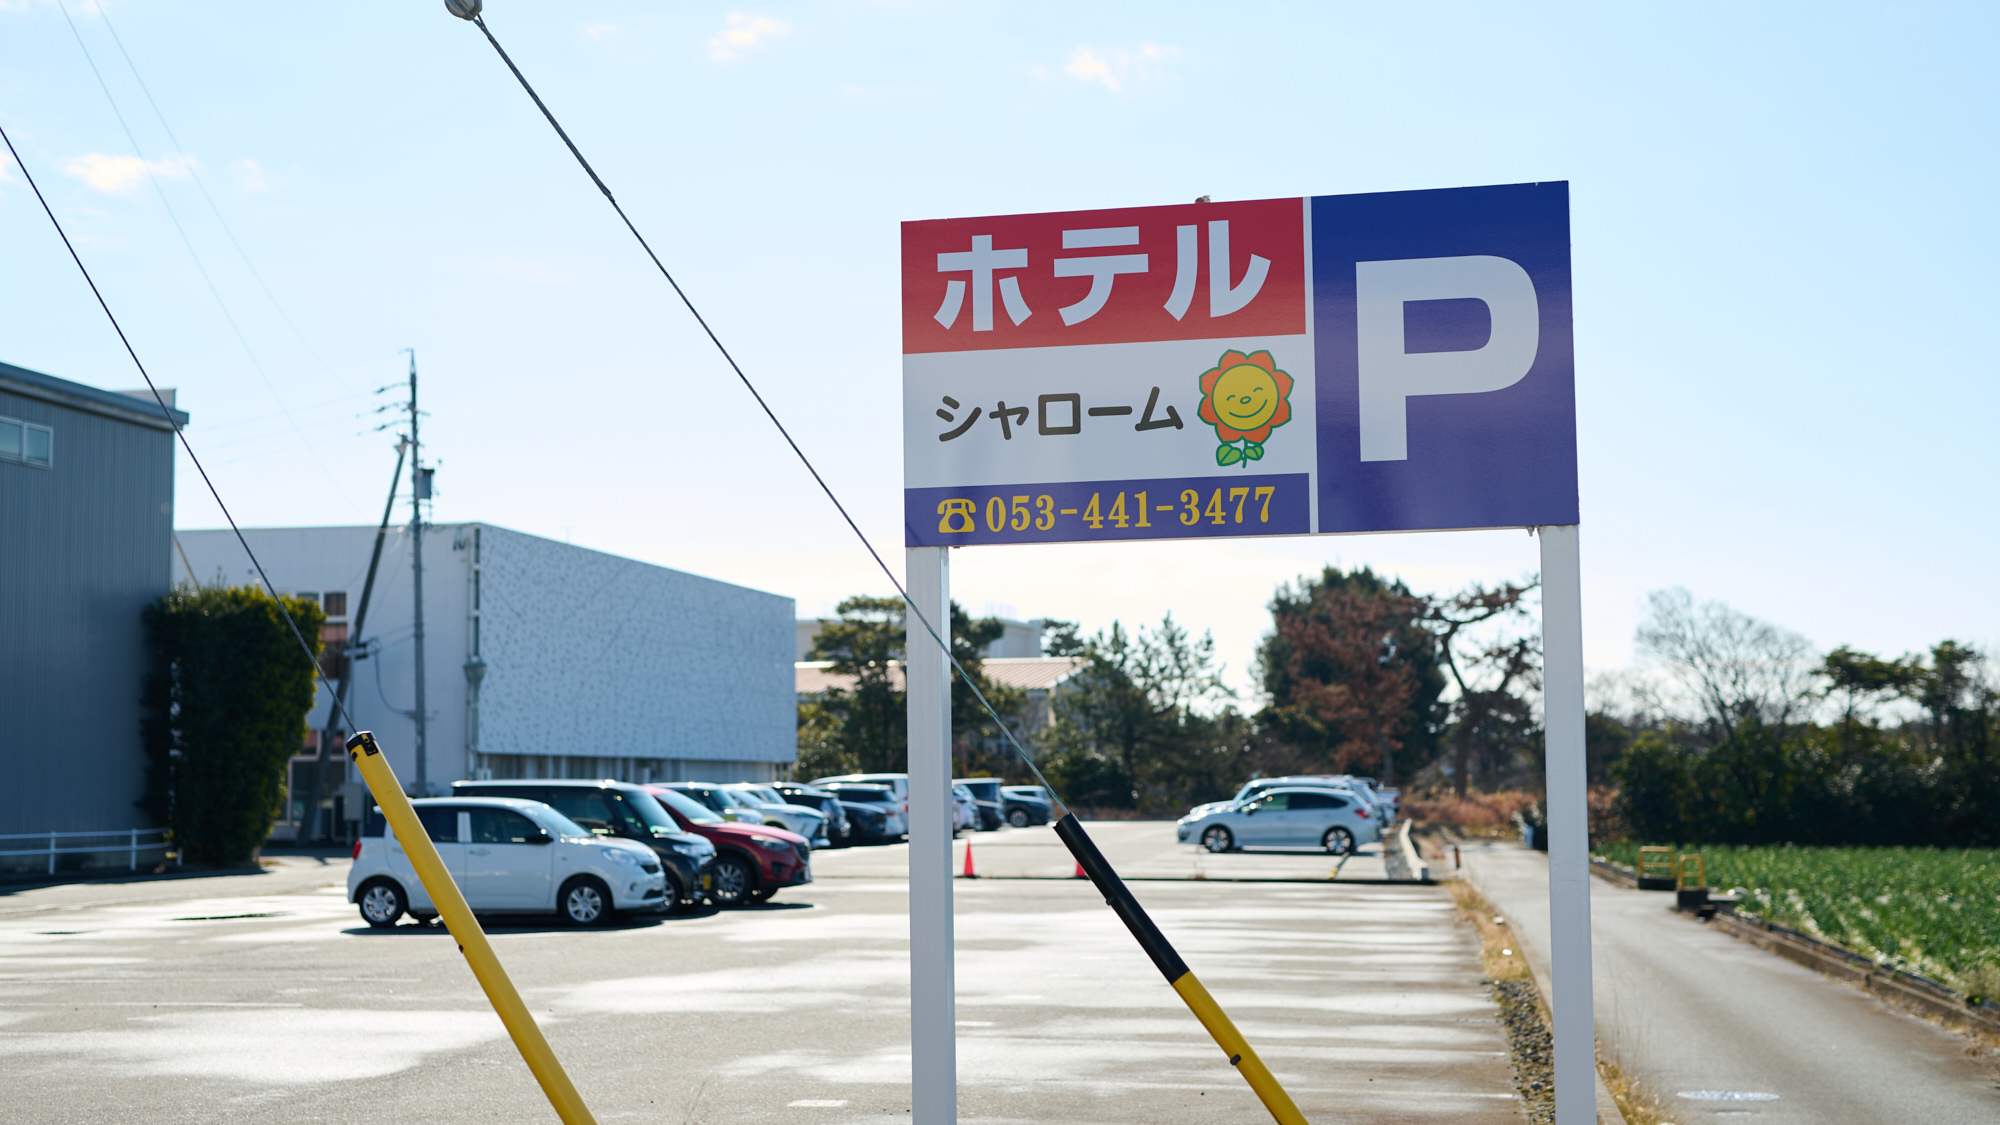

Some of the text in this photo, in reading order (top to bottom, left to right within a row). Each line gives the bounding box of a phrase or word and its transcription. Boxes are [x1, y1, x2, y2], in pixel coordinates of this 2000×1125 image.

[933, 219, 1272, 332] ホテル
[1356, 255, 1539, 462] P
[935, 386, 1184, 442] シャローム
[985, 486, 1275, 532] 053-441-3477
